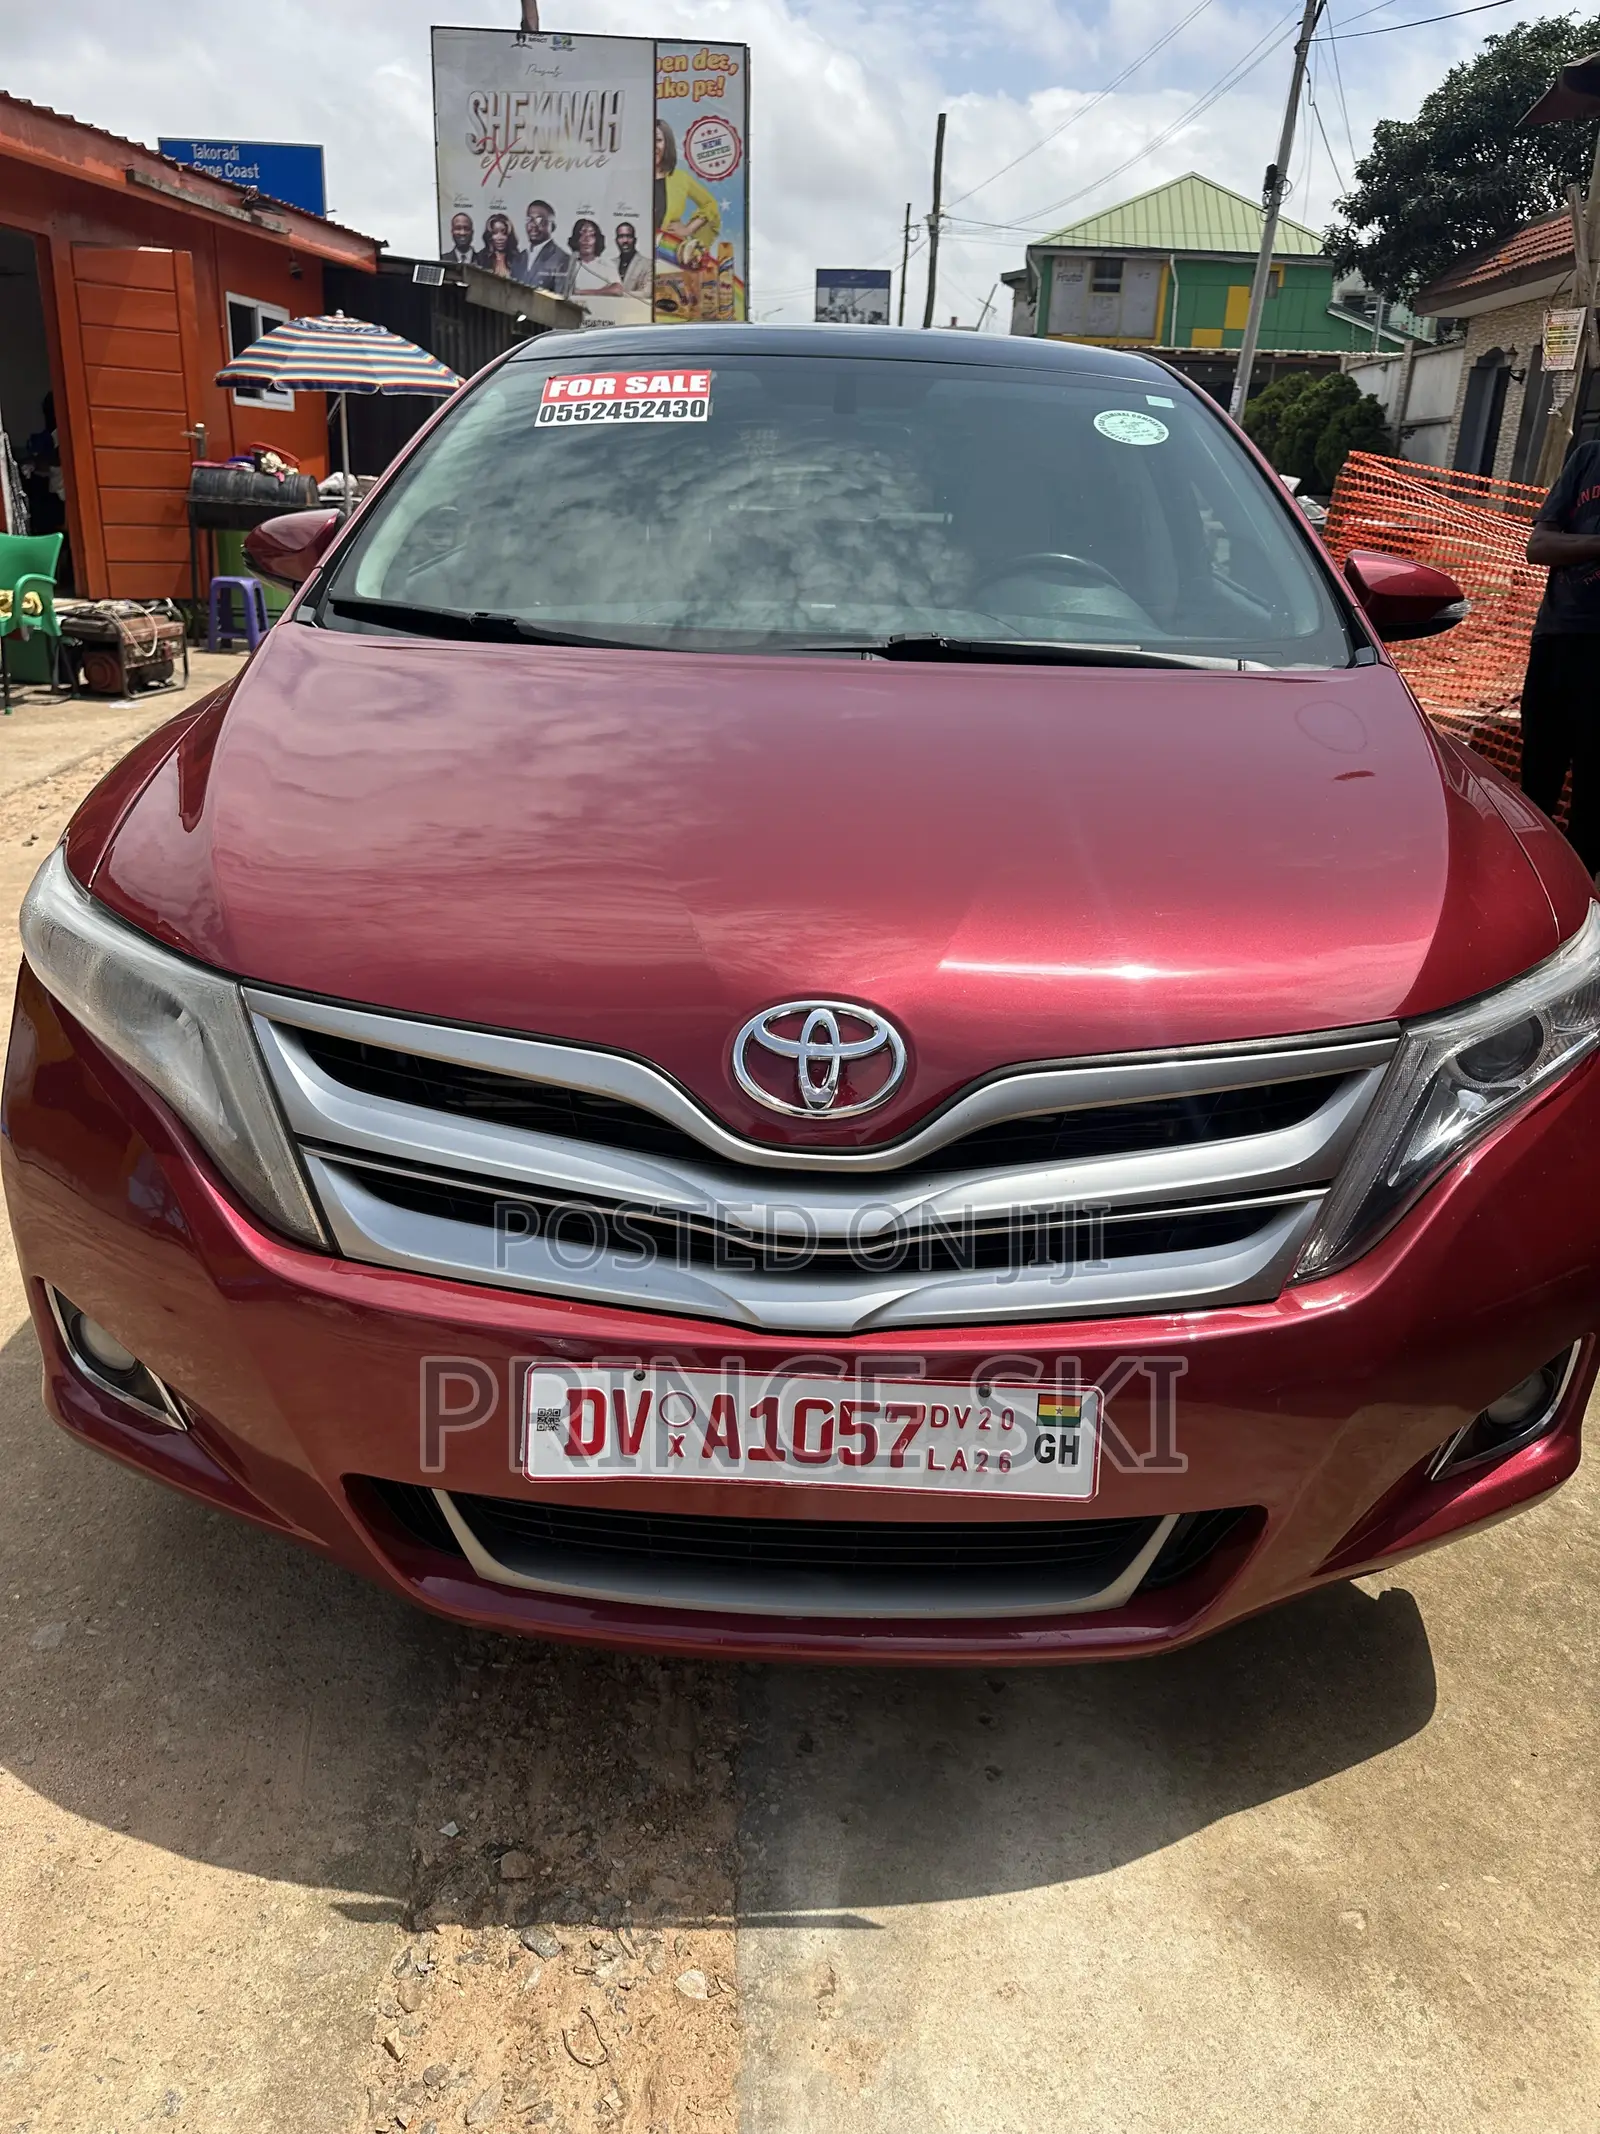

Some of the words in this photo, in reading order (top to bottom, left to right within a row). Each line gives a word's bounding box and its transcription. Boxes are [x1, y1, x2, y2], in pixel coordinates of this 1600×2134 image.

[465, 90, 625, 155] SHEKINAH
[191, 143, 240, 161] Takoradi
[224, 162, 261, 179] Coast
[548, 378, 617, 398] FOR
[624, 374, 708, 395] SALE
[539, 399, 706, 423] 0552452430
[563, 1387, 654, 1458] DV
[700, 1392, 927, 1469] A1057
[1034, 1433, 1081, 1466] GH
